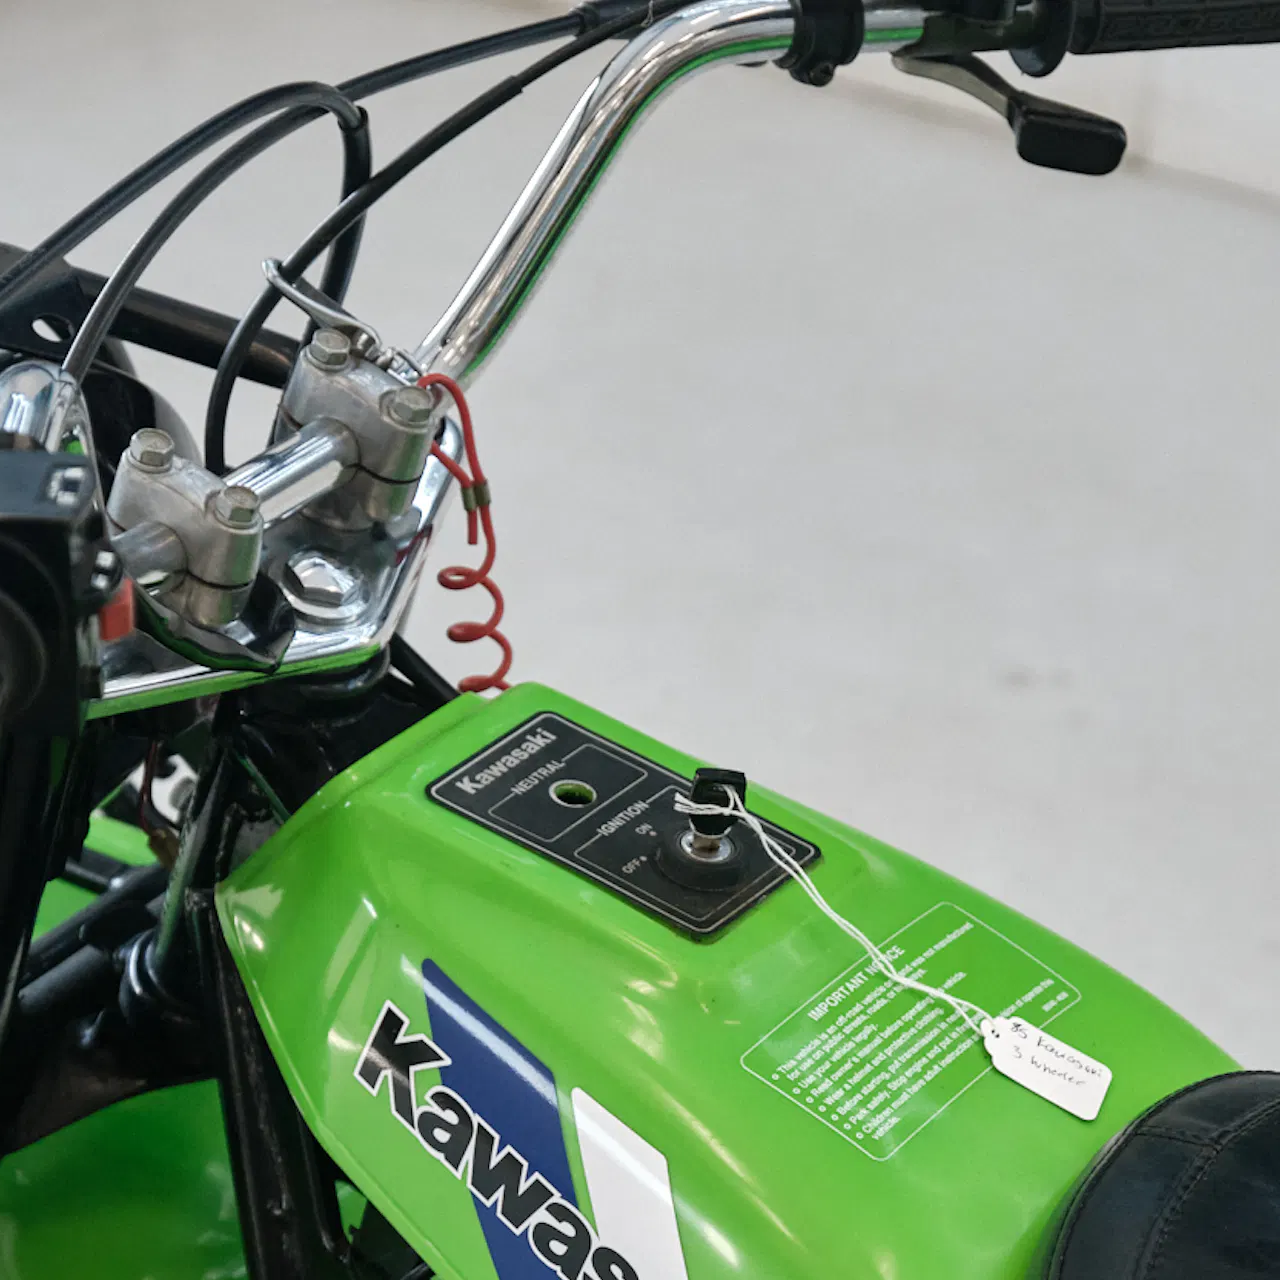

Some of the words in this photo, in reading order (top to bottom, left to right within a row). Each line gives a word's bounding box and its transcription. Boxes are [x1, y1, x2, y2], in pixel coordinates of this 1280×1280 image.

[455, 728, 557, 795] Kawasaki
[512, 760, 565, 795] NEUTRAL
[597, 801, 649, 836] IGNITION
[635, 823, 652, 835] ON
[622, 858, 641, 874] OFF
[807, 971, 869, 1021] IMPORTANT
[776, 1059, 798, 1074] This
[794, 1038, 822, 1061] vehicle
[818, 1032, 829, 1041] is
[826, 1024, 838, 1035] an
[835, 1002, 865, 1027] off-road
[861, 985, 887, 1005] vehicle
[786, 1069, 801, 1081] for
[799, 1058, 815, 1072] use
[812, 1049, 825, 1060] on
[821, 1032, 845, 1053] public
[886, 990, 897, 999] or
[810, 1078, 834, 1097] Read
[830, 1056, 860, 1082] owner's
[856, 1035, 884, 1059] manual
[878, 1019, 904, 1039] before
[901, 996, 935, 1022] operating
[883, 1027, 918, 1057] protective
[1011, 1022, 1028, 1039] 85
[798, 1074, 818, 1089] Use
[813, 1060, 832, 1079] your
[829, 1041, 856, 1062] vehicle
[851, 1024, 879, 1043] legally.
[836, 1093, 864, 1116] Before
[888, 1059, 902, 1074] put
[897, 1027, 942, 1063] transmission
[936, 1021, 949, 1030] in
[871, 1052, 887, 1067] and
[1012, 1045, 1022, 1059] 3
[843, 1083, 852, 1091] a
[847, 1063, 874, 1086] helmet
[848, 1108, 870, 1125] Park
[887, 1075, 908, 1091] Stop
[904, 1056, 930, 1078] engine
[926, 1045, 942, 1060] and
[938, 1036, 953, 1050] put
[948, 1031, 960, 1039] in
[862, 1107, 894, 1134] Children
[890, 1091, 911, 1110] must
[905, 1079, 926, 1095] have
[923, 1064, 943, 1082] adult
[938, 1038, 974, 1068] instruction
[823, 1088, 845, 1105] Wear
